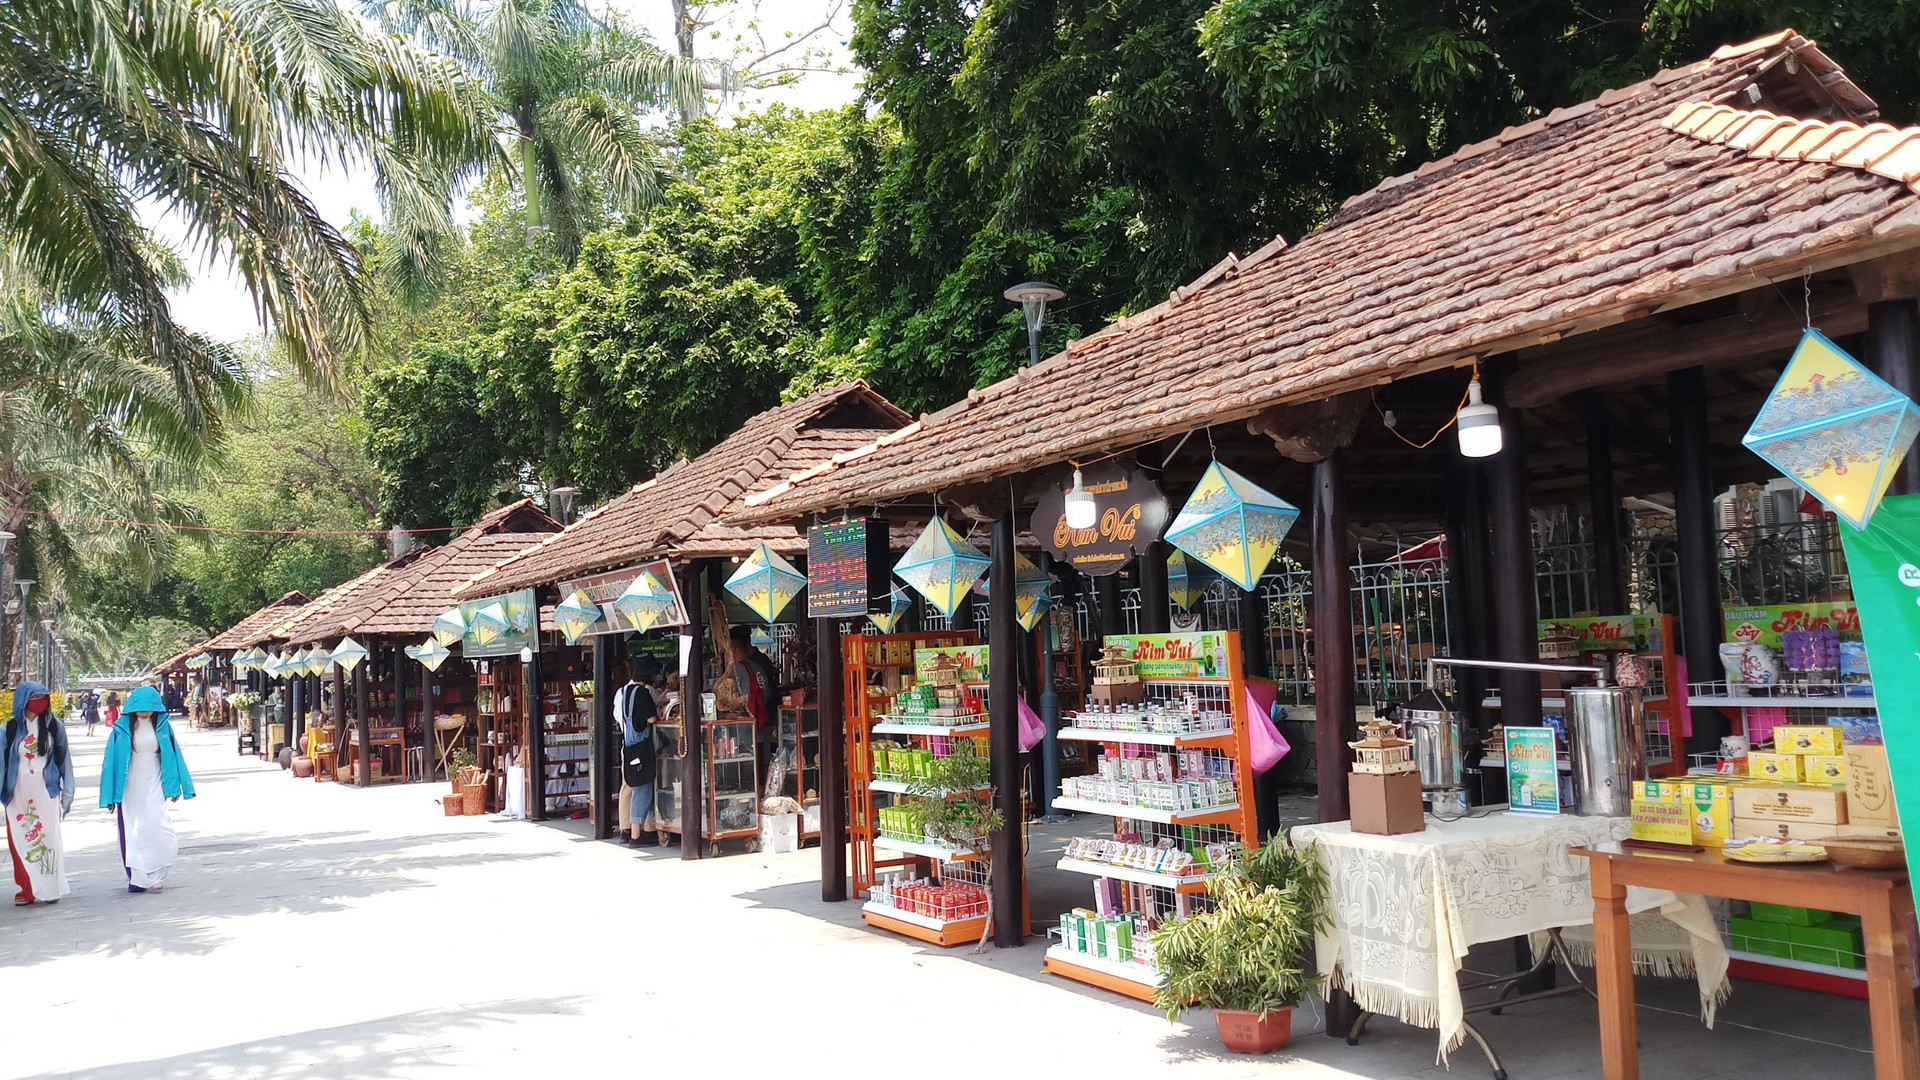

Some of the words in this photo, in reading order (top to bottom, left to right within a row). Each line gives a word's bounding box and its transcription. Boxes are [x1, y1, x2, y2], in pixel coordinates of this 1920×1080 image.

[1101, 503, 1140, 543] Vui
[1589, 621, 1622, 640] Vui
[1132, 640, 1166, 661] Kim
[1165, 638, 1193, 660] Vui
[1509, 743, 1533, 758] Kim
[1533, 744, 1552, 759] Vui
